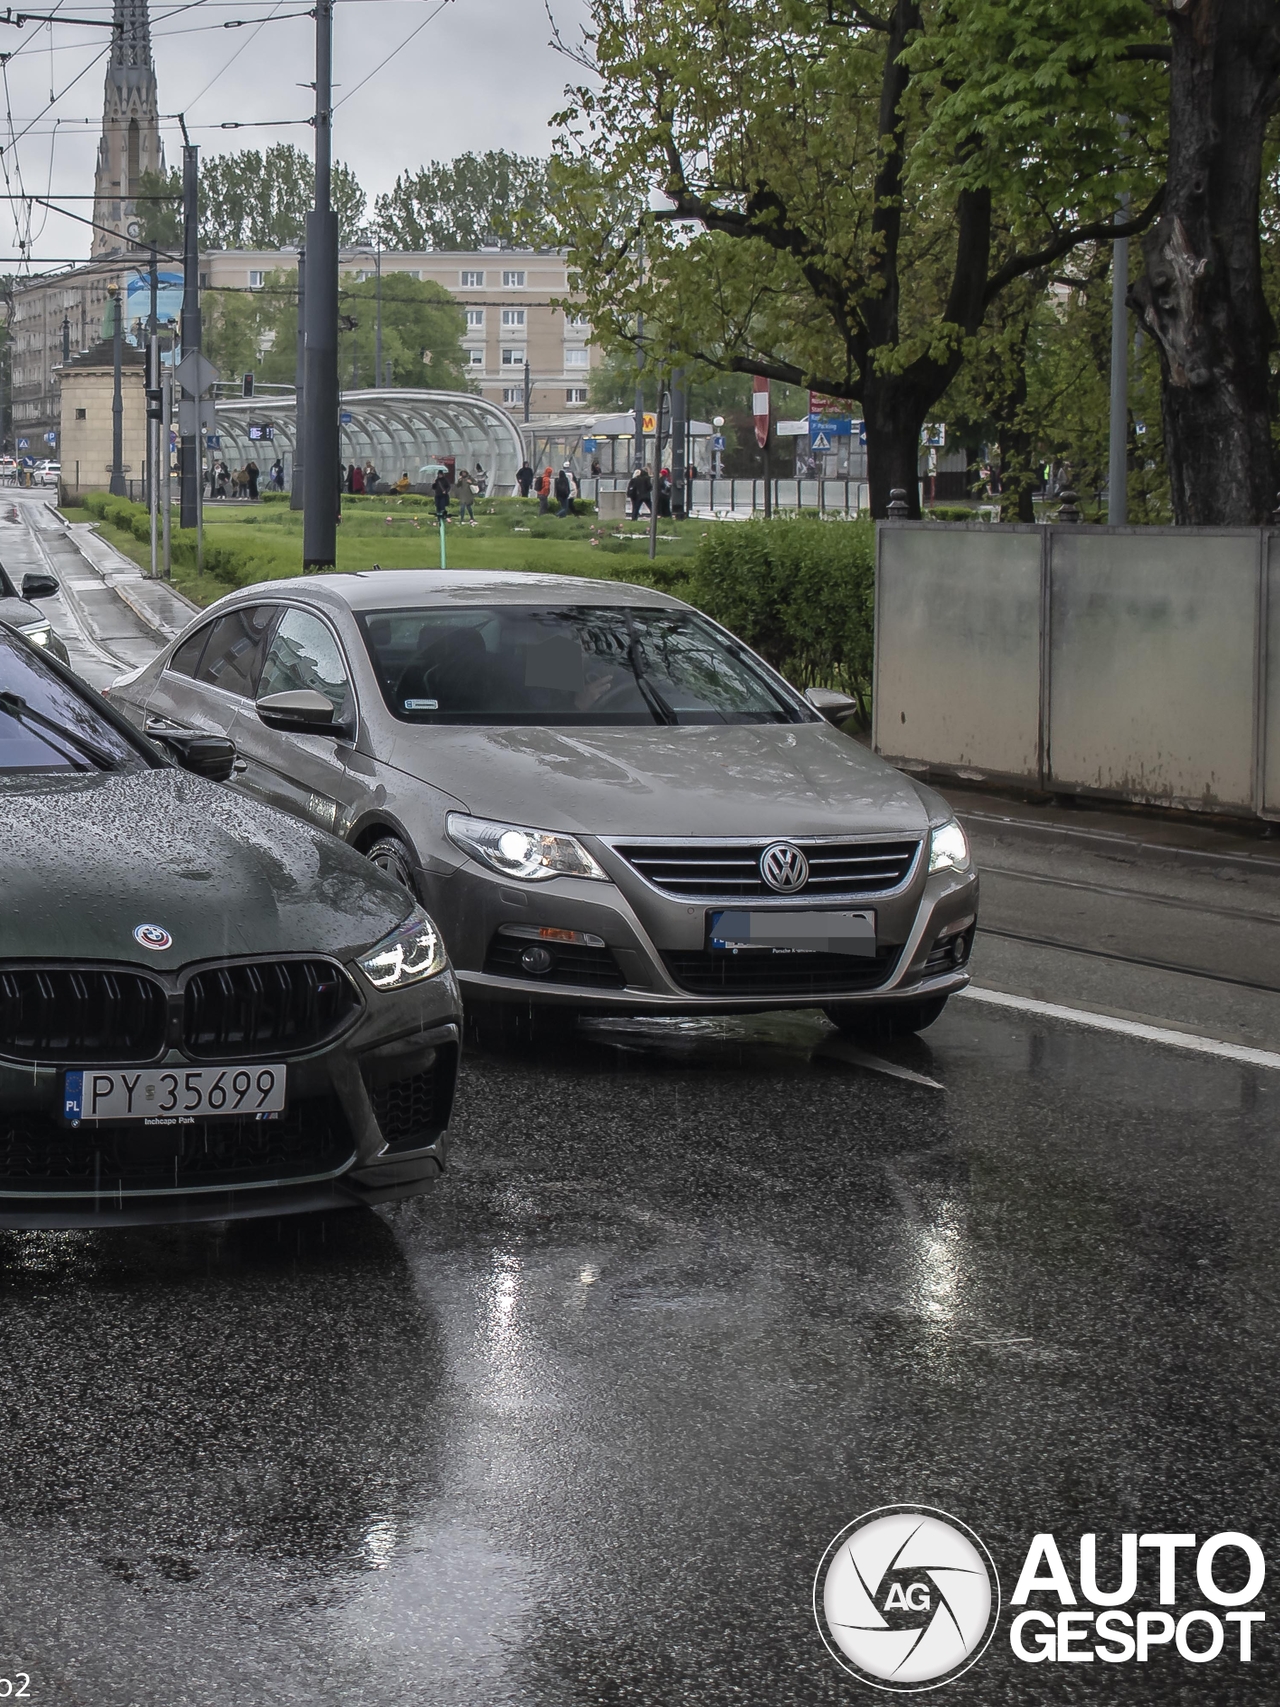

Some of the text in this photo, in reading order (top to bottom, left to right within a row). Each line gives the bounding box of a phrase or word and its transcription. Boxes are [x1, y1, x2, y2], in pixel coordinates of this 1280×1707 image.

[91, 1068, 277, 1115] PY 35699
[66, 1100, 80, 1111] PL
[144, 1116, 195, 1125] Inchcape Park
